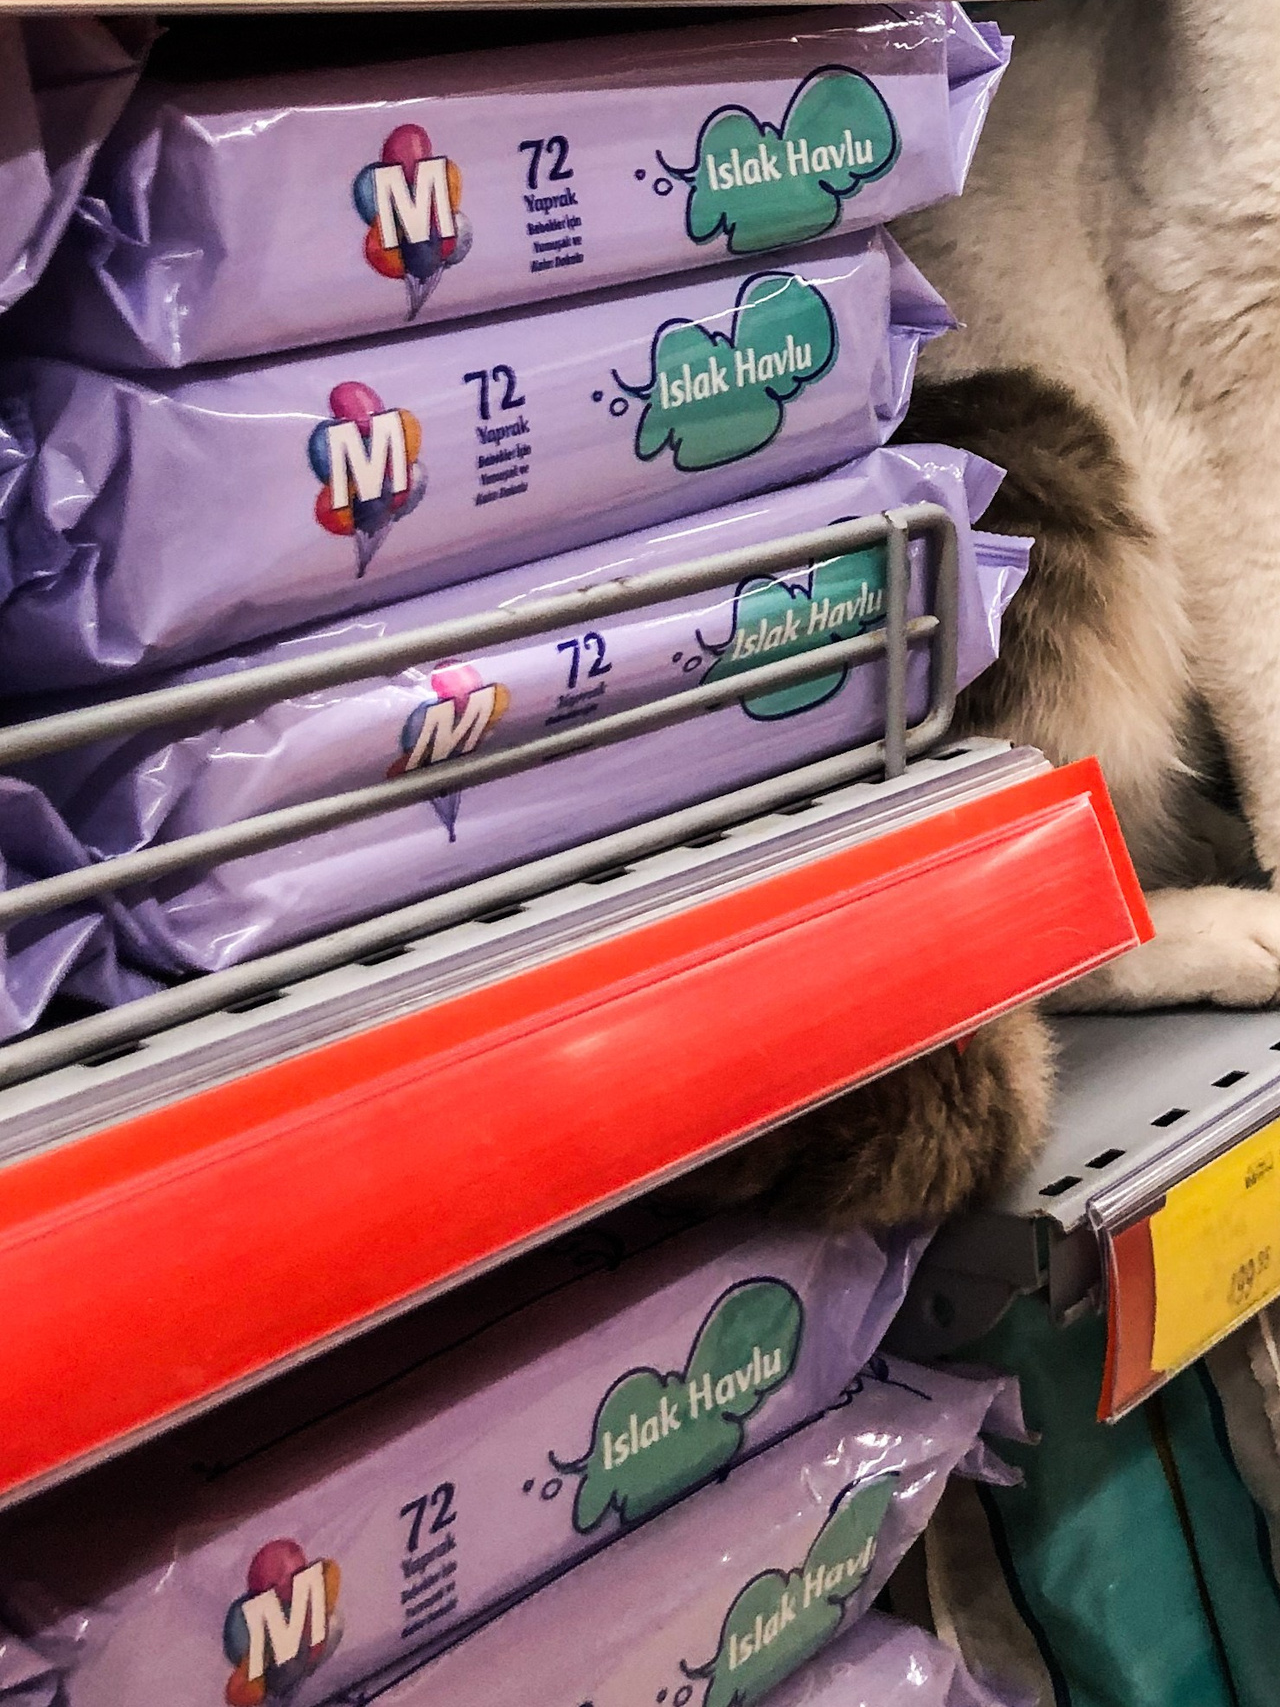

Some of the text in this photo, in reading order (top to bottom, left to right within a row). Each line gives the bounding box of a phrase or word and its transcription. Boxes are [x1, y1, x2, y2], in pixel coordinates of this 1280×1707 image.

[518, 135, 575, 190] 72
[706, 127, 875, 193] Islak Havlu
[523, 186, 579, 215] Yaprak
[463, 364, 527, 421] 72
[658, 334, 813, 411] Islak Havlu
[475, 414, 531, 447] Yaprak
[730, 580, 883, 662] Islak Havlu
[556, 631, 614, 690] 72
[602, 1343, 784, 1471] Islak Havlu
[399, 1481, 458, 1554] 72
[728, 1590, 797, 1671] Islak
